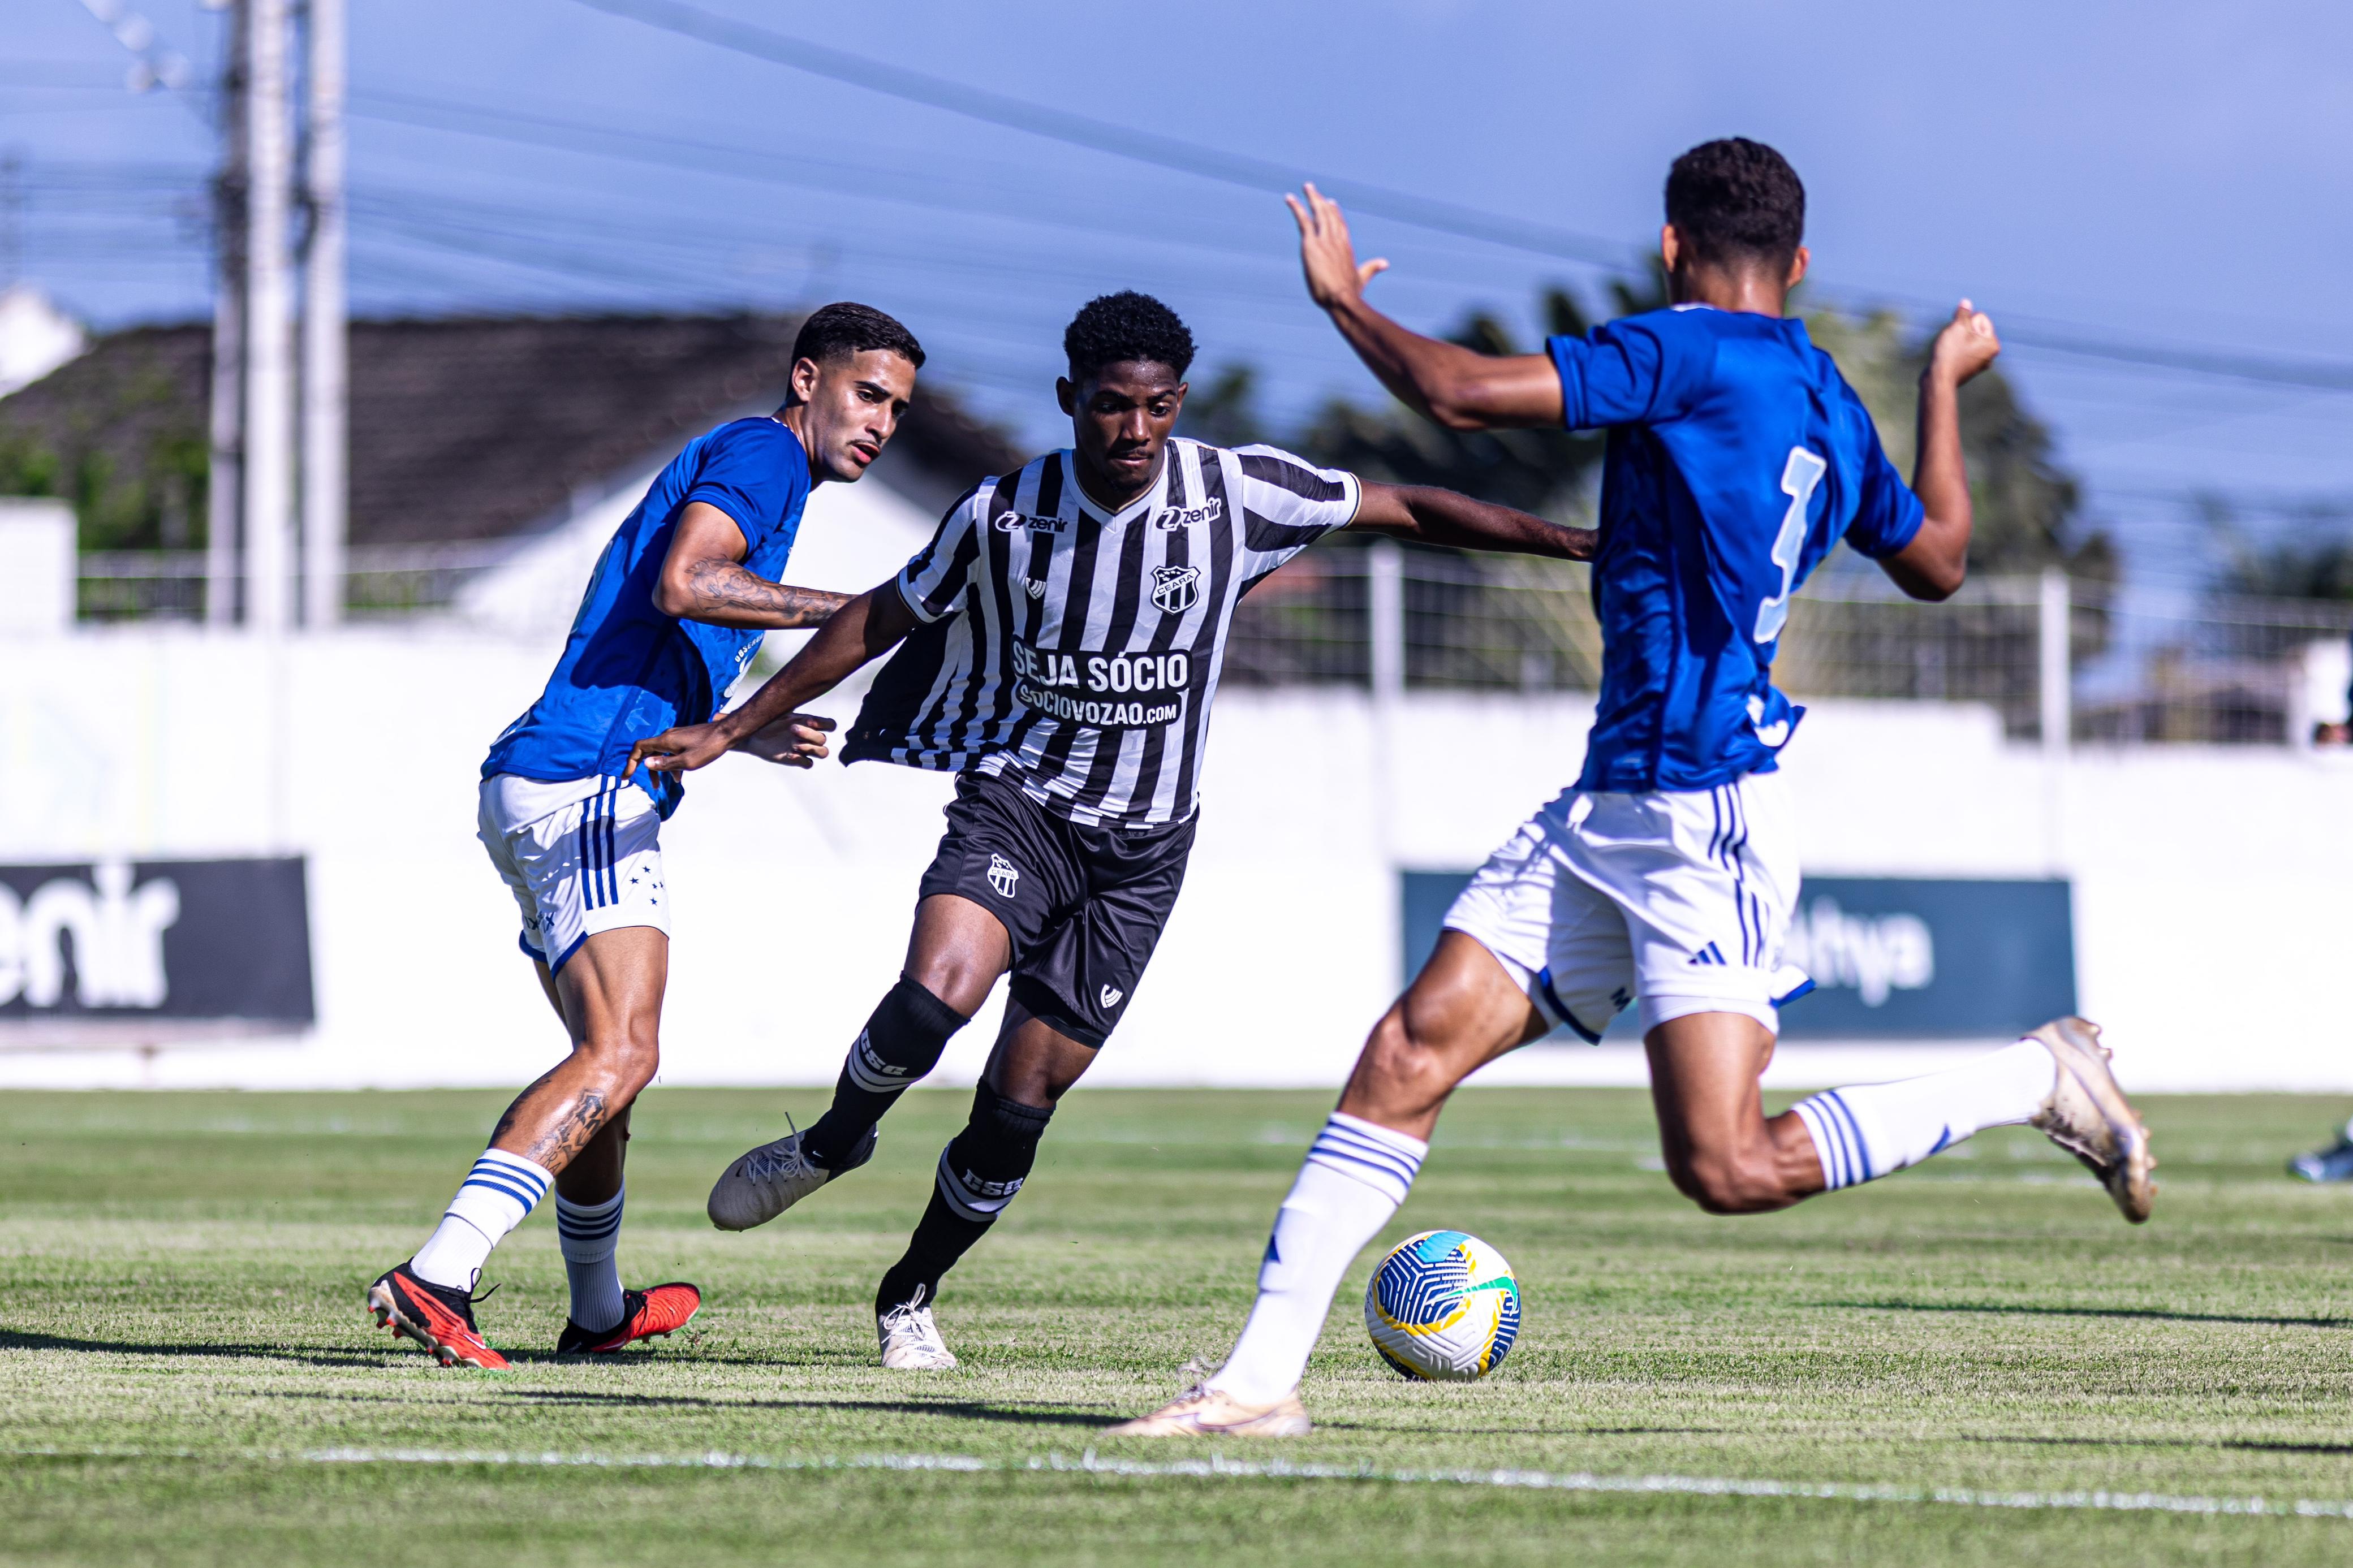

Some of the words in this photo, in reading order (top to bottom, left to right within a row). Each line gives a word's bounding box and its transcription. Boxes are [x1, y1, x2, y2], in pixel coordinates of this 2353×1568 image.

[1183, 500, 1219, 524] zenir
[1028, 517, 1068, 533] zenir
[1013, 641, 1080, 689] SEJA
[1087, 651, 1188, 693] SÓCIO
